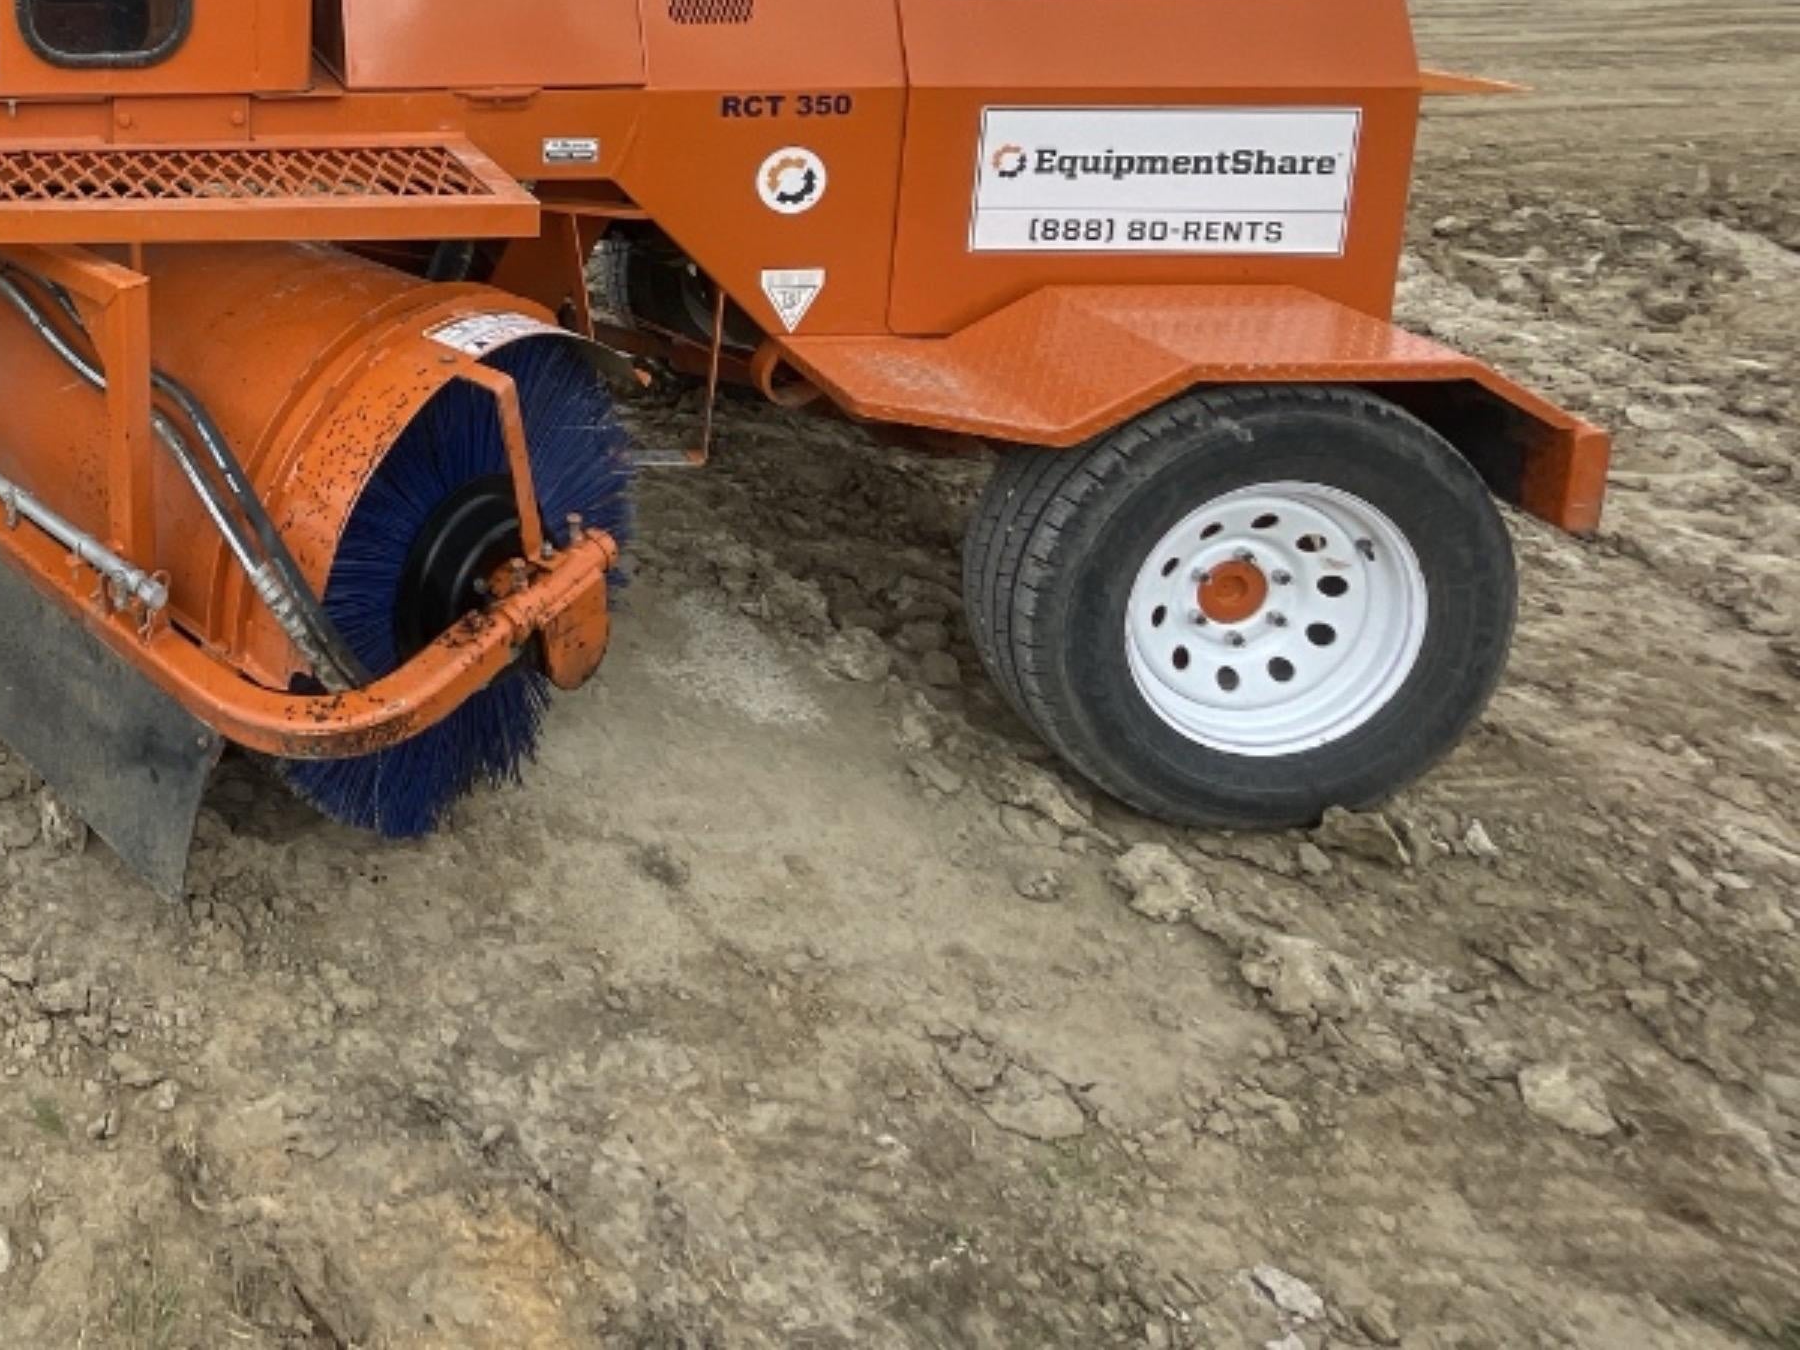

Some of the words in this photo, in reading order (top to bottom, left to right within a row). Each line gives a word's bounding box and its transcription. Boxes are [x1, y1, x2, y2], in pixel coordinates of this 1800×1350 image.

[720, 95, 786, 118] RCT
[795, 94, 853, 116] 350
[1034, 148, 1336, 181] EquipmentShare
[1028, 217, 1115, 244] (888)
[1126, 219, 1284, 244] 80-RENTS
